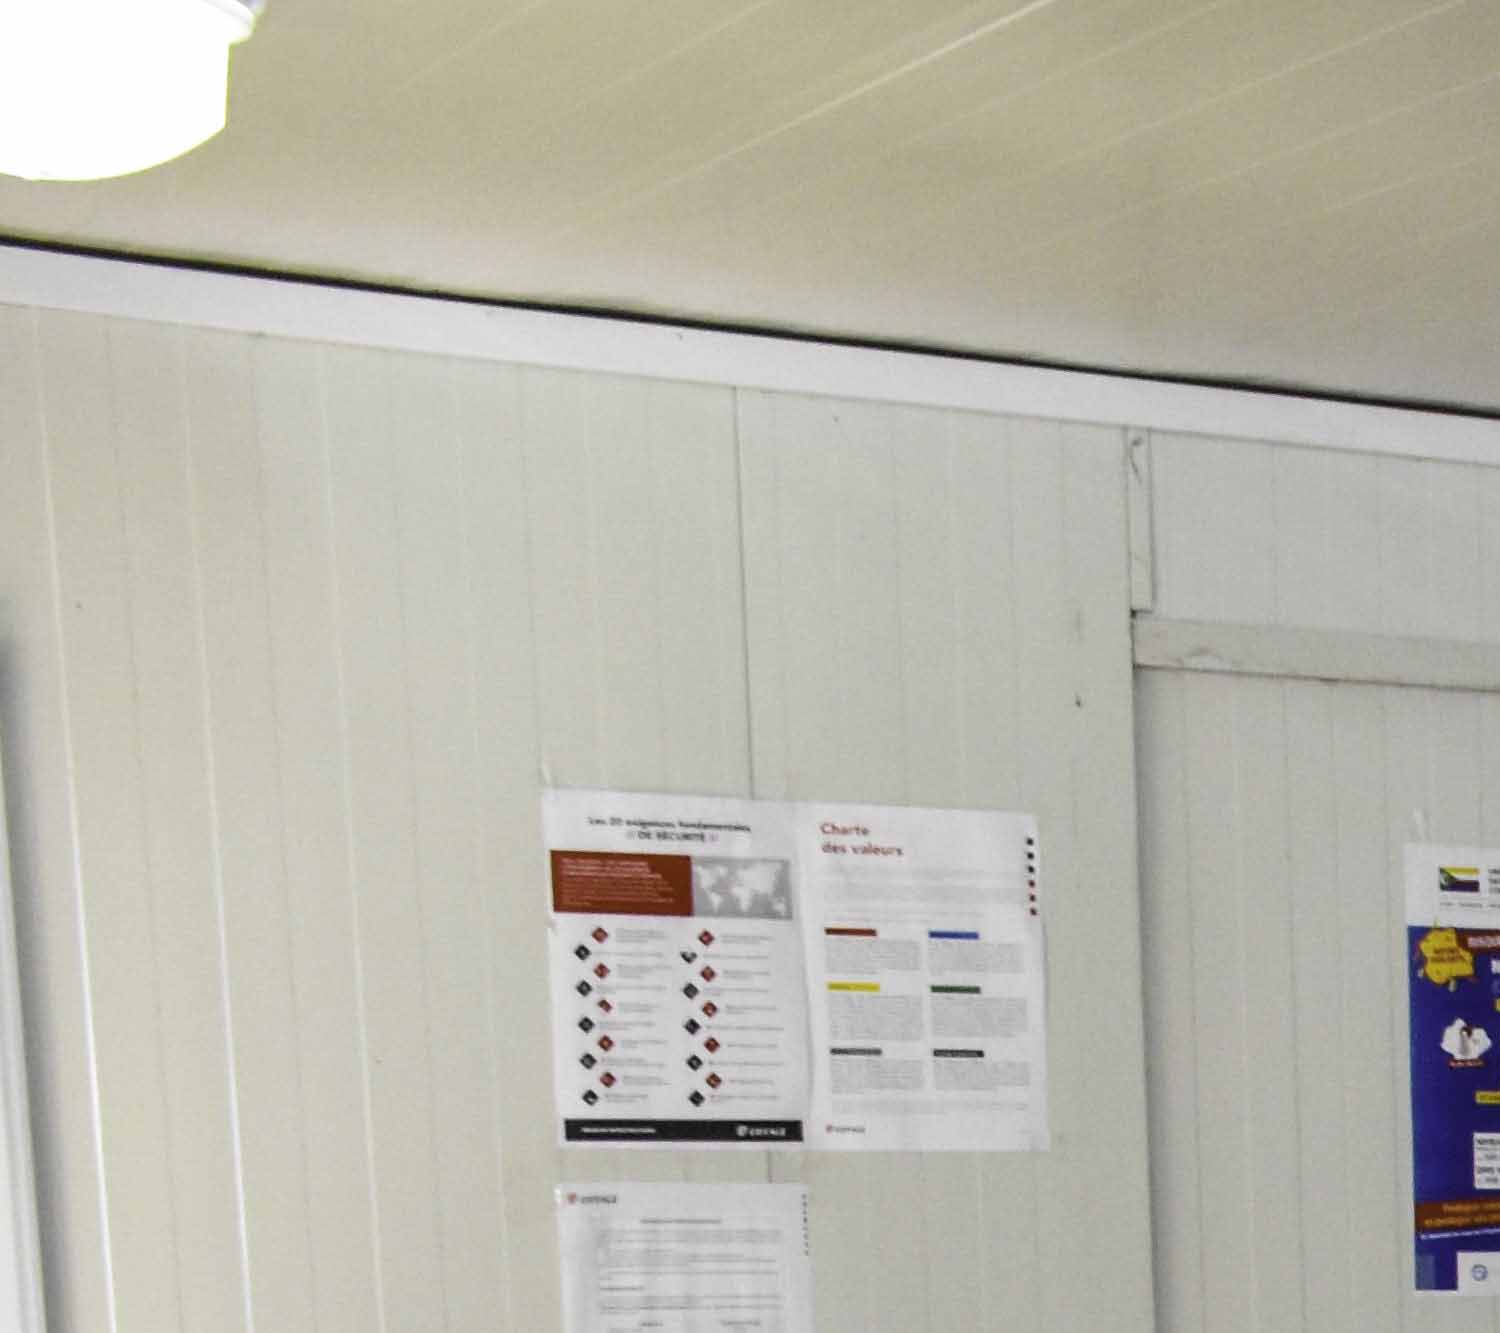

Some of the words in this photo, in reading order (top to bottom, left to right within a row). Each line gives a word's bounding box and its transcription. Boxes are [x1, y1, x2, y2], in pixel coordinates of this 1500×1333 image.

[820, 823, 870, 835] Charte
[821, 842, 847, 854] des
[851, 843, 903, 856] valeurs
